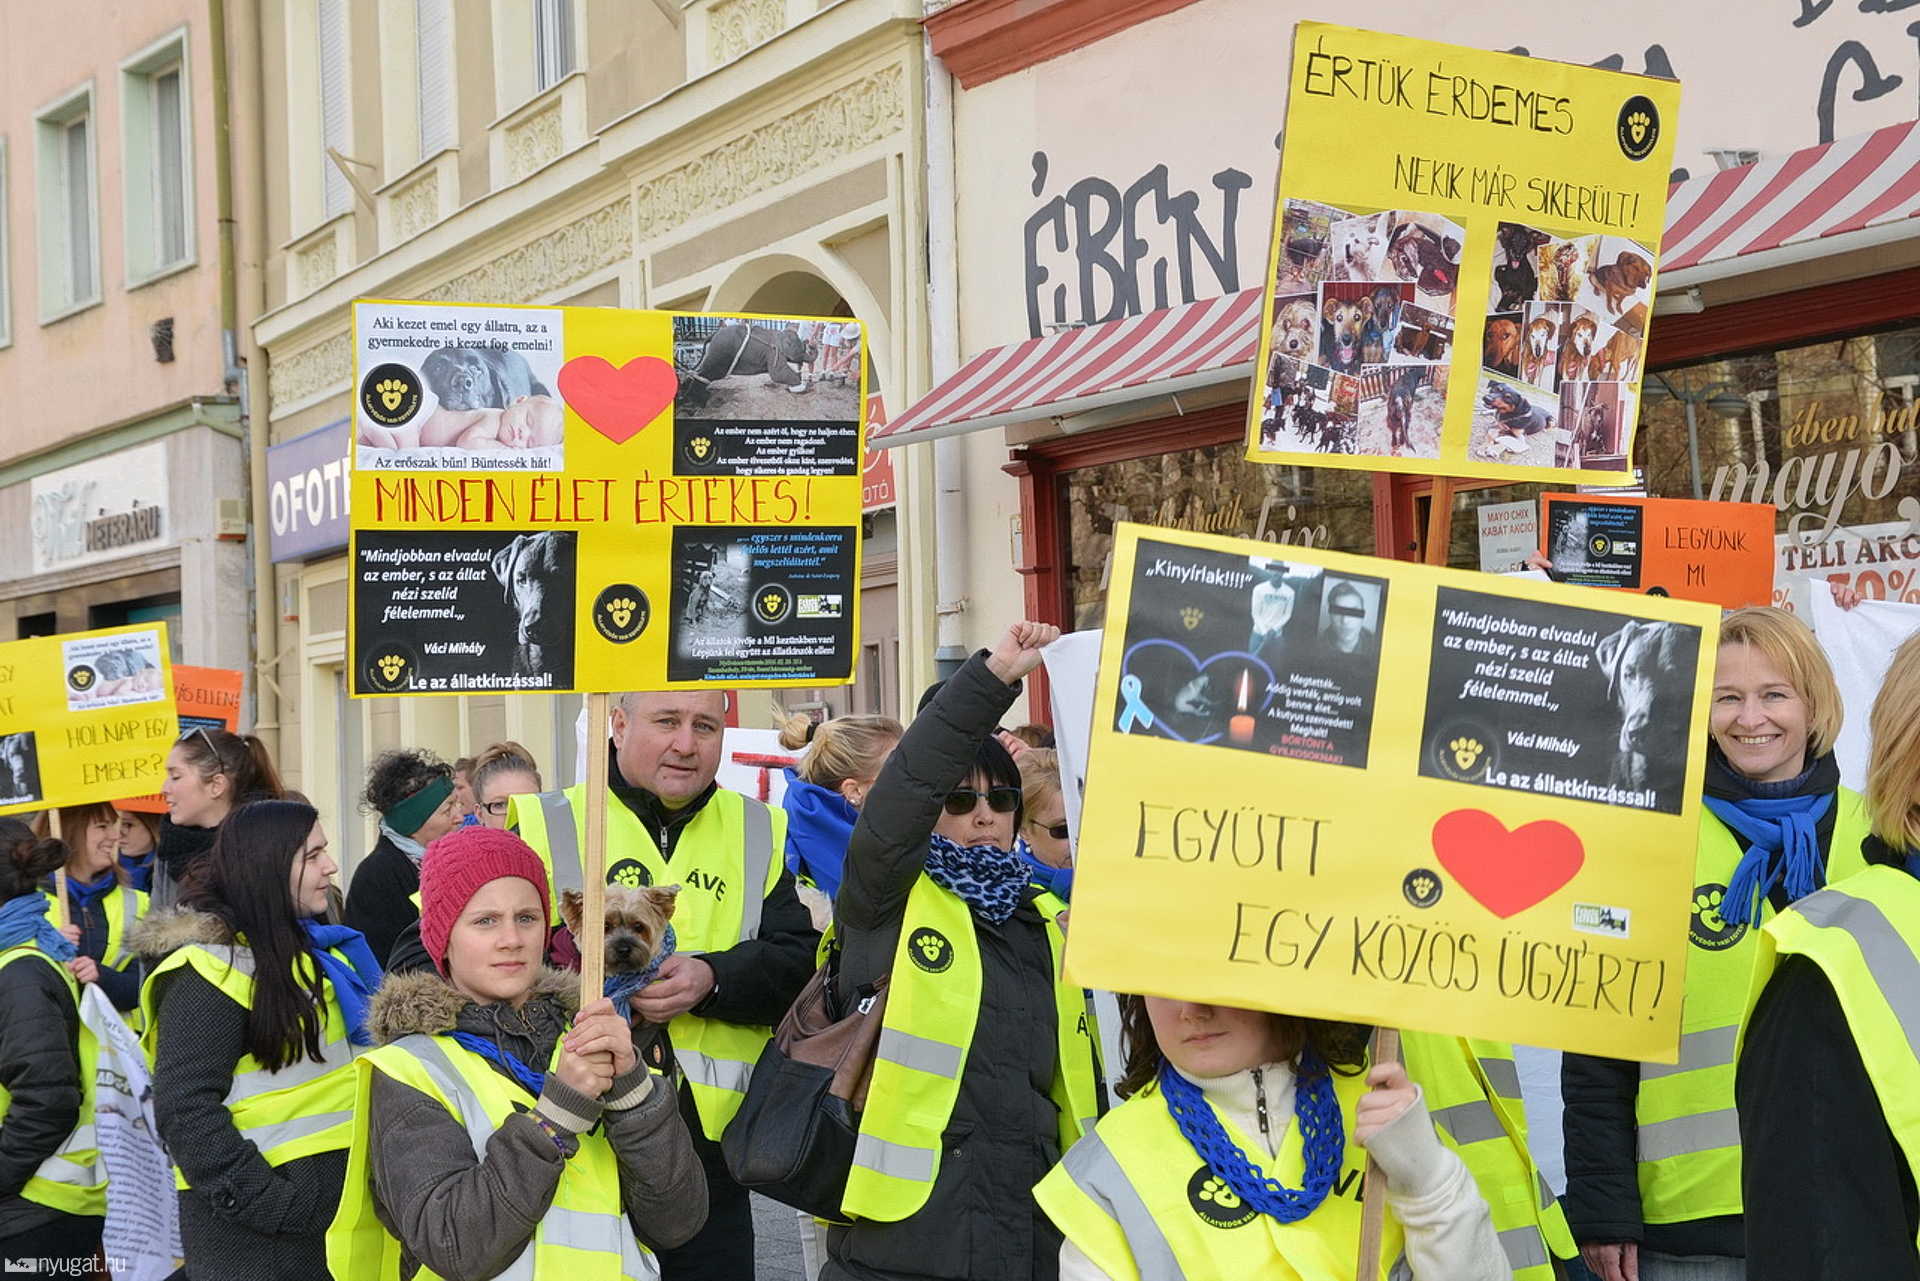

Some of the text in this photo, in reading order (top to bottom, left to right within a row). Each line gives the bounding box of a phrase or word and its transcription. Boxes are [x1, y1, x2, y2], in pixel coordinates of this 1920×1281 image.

[1304, 35, 1573, 135] ÉRTÜK ÉRDEMES
[1394, 154, 1640, 228] NEKIK MÁR SIKERÜLT!
[373, 318, 394, 330] Aki
[397, 320, 426, 330] kezet
[430, 320, 457, 331] emel
[461, 324, 480, 334] egy
[484, 321, 522, 334] állatra,
[526, 325, 539, 333] az
[368, 338, 553, 352] gyermekedre is kezet fog emelni!
[375, 457, 391, 468] Az
[394, 457, 437, 468] erőszak
[471, 457, 527, 469] Büntessék
[530, 458, 551, 469] hát!
[374, 470, 812, 524] MINDEN ÉLET ÉRTÉKES!
[1665, 525, 1749, 551] LEGYÜNK
[444, 549, 491, 562] elvadul
[1782, 536, 1846, 571] TÉLI
[364, 568, 486, 584] az ember, s az állat
[1687, 563, 1706, 587] MI
[392, 587, 458, 600] nézi szelíd
[1540, 625, 1598, 648] elvadul
[424, 643, 486, 656] Váci Mihály
[1443, 636, 1590, 669] az ember, s az állat
[409, 675, 426, 690] Le
[431, 679, 447, 689] az
[450, 673, 552, 689] állatkínzással!
[1474, 661, 1555, 685] nézi szelíd
[66, 720, 141, 749] HOLNAP
[145, 718, 169, 742] EGY
[1535, 734, 1581, 757] Mihály
[82, 753, 163, 785] EMBER?
[1485, 766, 1657, 808] Le az állatkínzással!
[1134, 801, 1333, 877] EGYÜTT
[685, 868, 727, 902] ÁVE
[1227, 901, 1666, 1022] EGY KÖZÖS ÜGYÉRT!
